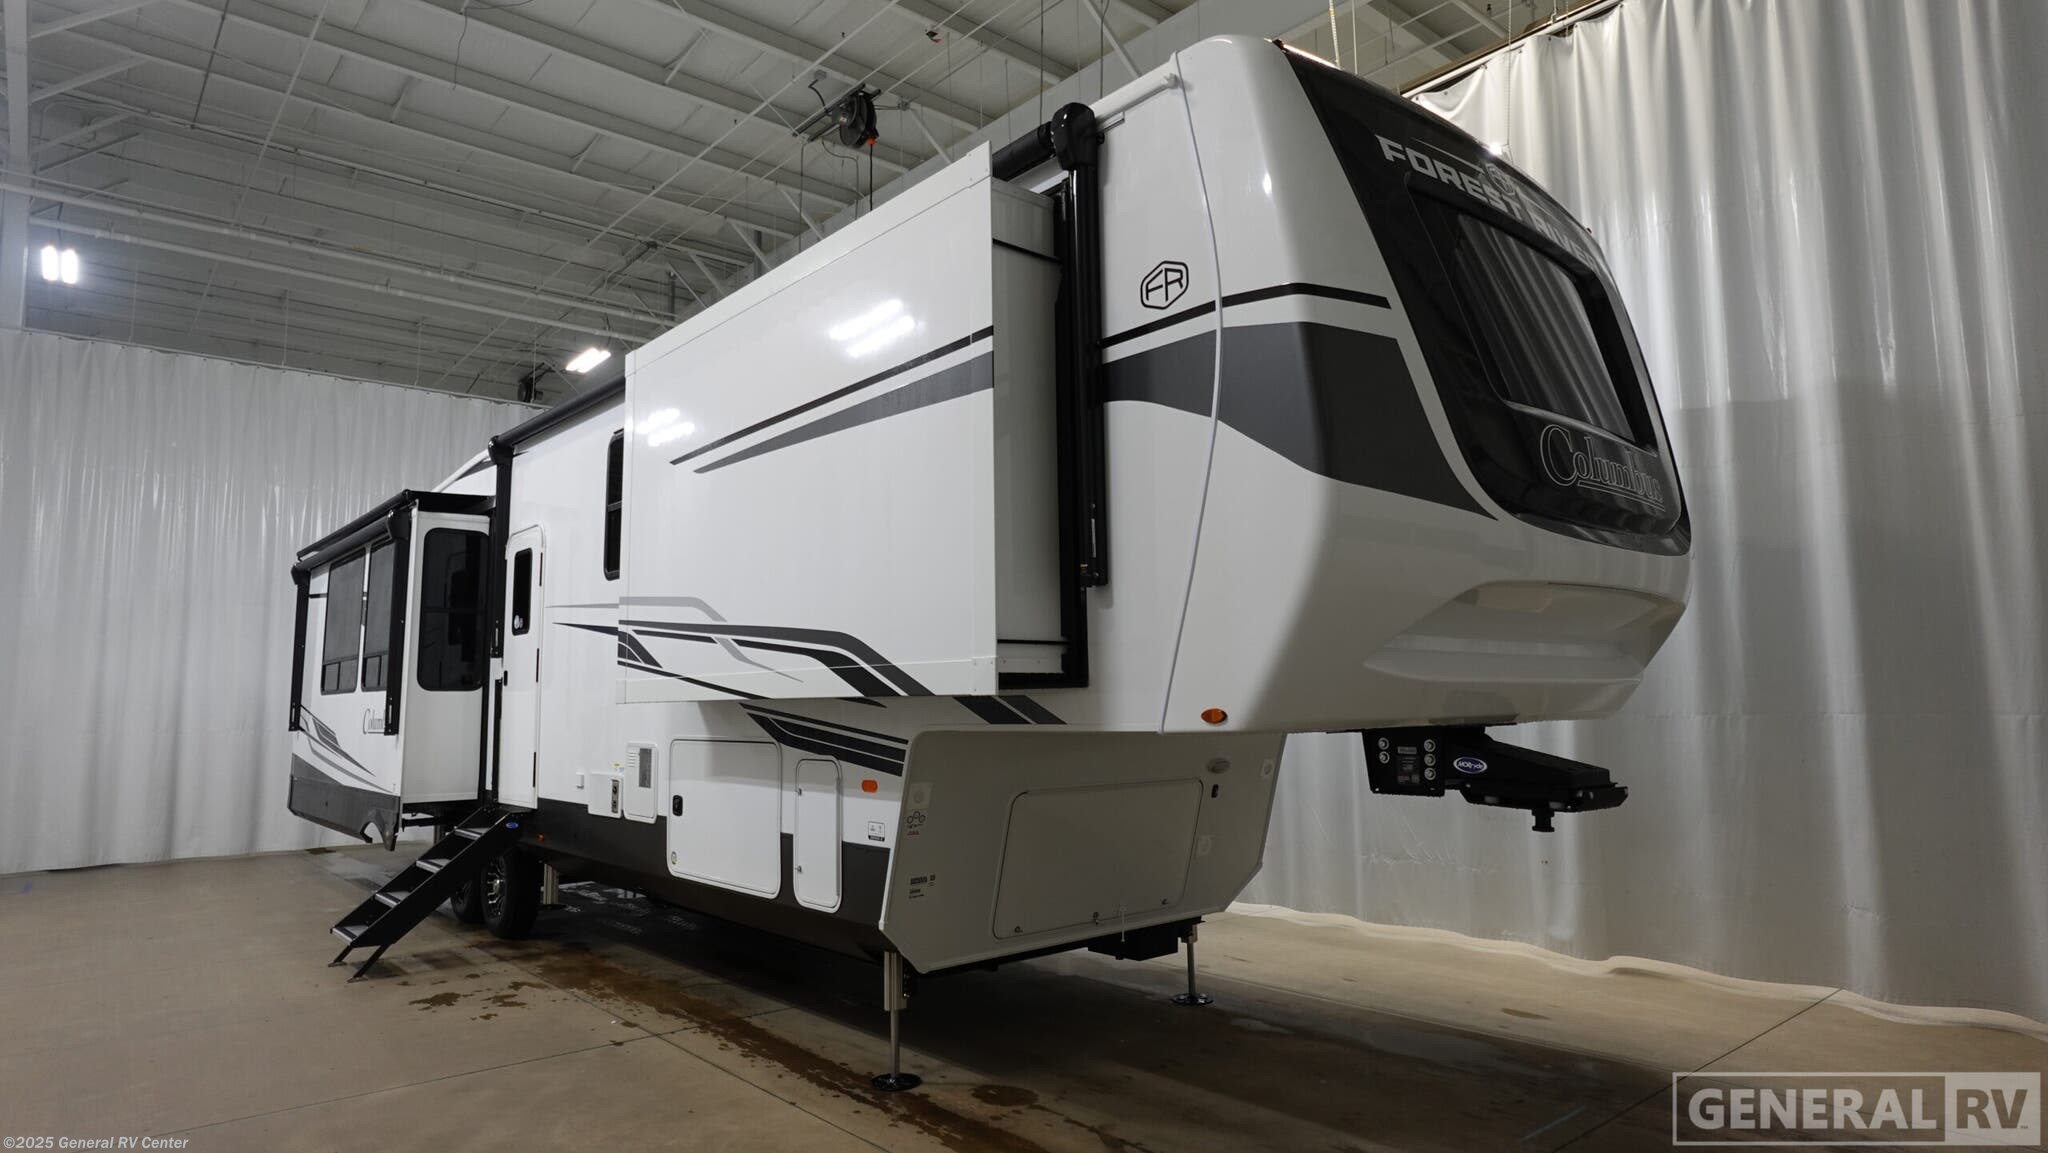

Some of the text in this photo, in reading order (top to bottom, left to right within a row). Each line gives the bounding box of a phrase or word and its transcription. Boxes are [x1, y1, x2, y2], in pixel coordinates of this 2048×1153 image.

[1375, 134, 1523, 220] FOREST
[1145, 267, 1184, 303] FR
[1541, 423, 1664, 506] Columbus
[363, 708, 386, 735] Colum
